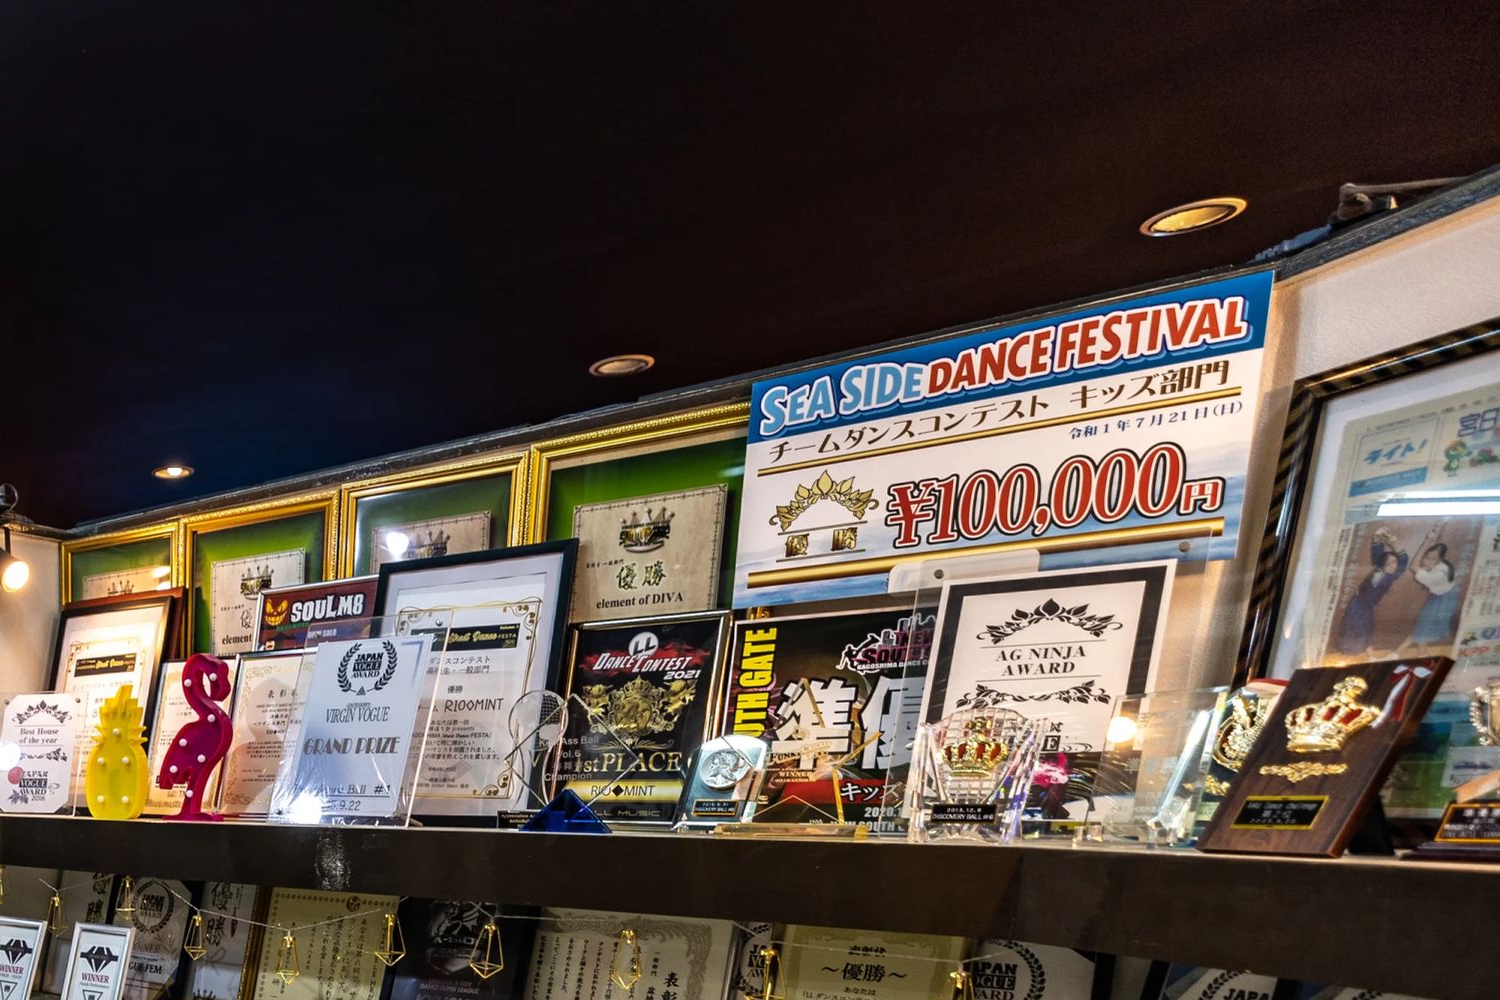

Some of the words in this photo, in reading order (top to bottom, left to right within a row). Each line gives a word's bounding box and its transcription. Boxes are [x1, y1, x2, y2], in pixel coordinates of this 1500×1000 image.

[759, 376, 832, 435] SEA
[842, 362, 924, 415] SIDE
[927, 330, 1054, 397] DANCE
[1055, 297, 1248, 370] FESTIVAL
[768, 395, 1050, 464] チームダンスコンテスト
[1070, 359, 1230, 410] キッズ部門
[596, 595, 636, 609] element
[638, 595, 649, 606] of
[652, 591, 684, 604] DIVA
[222, 634, 252, 646] element
[355, 652, 384, 662] JAPAN
[739, 628, 777, 687] GATE
[995, 648, 1025, 663] AG
[1028, 645, 1087, 659] NINJA
[353, 661, 382, 671] VOGUE
[1001, 661, 1076, 677] AWARD
[351, 670, 380, 679] AWARD
[664, 670, 701, 680] 2021
[326, 707, 355, 723] VIRGIN
[358, 706, 391, 722] VOGUE
[303, 737, 353, 755] GRAND
[355, 736, 400, 754] PRIZE
[0, 964, 24, 975] WINNER
[81, 972, 109, 984] WINNER
